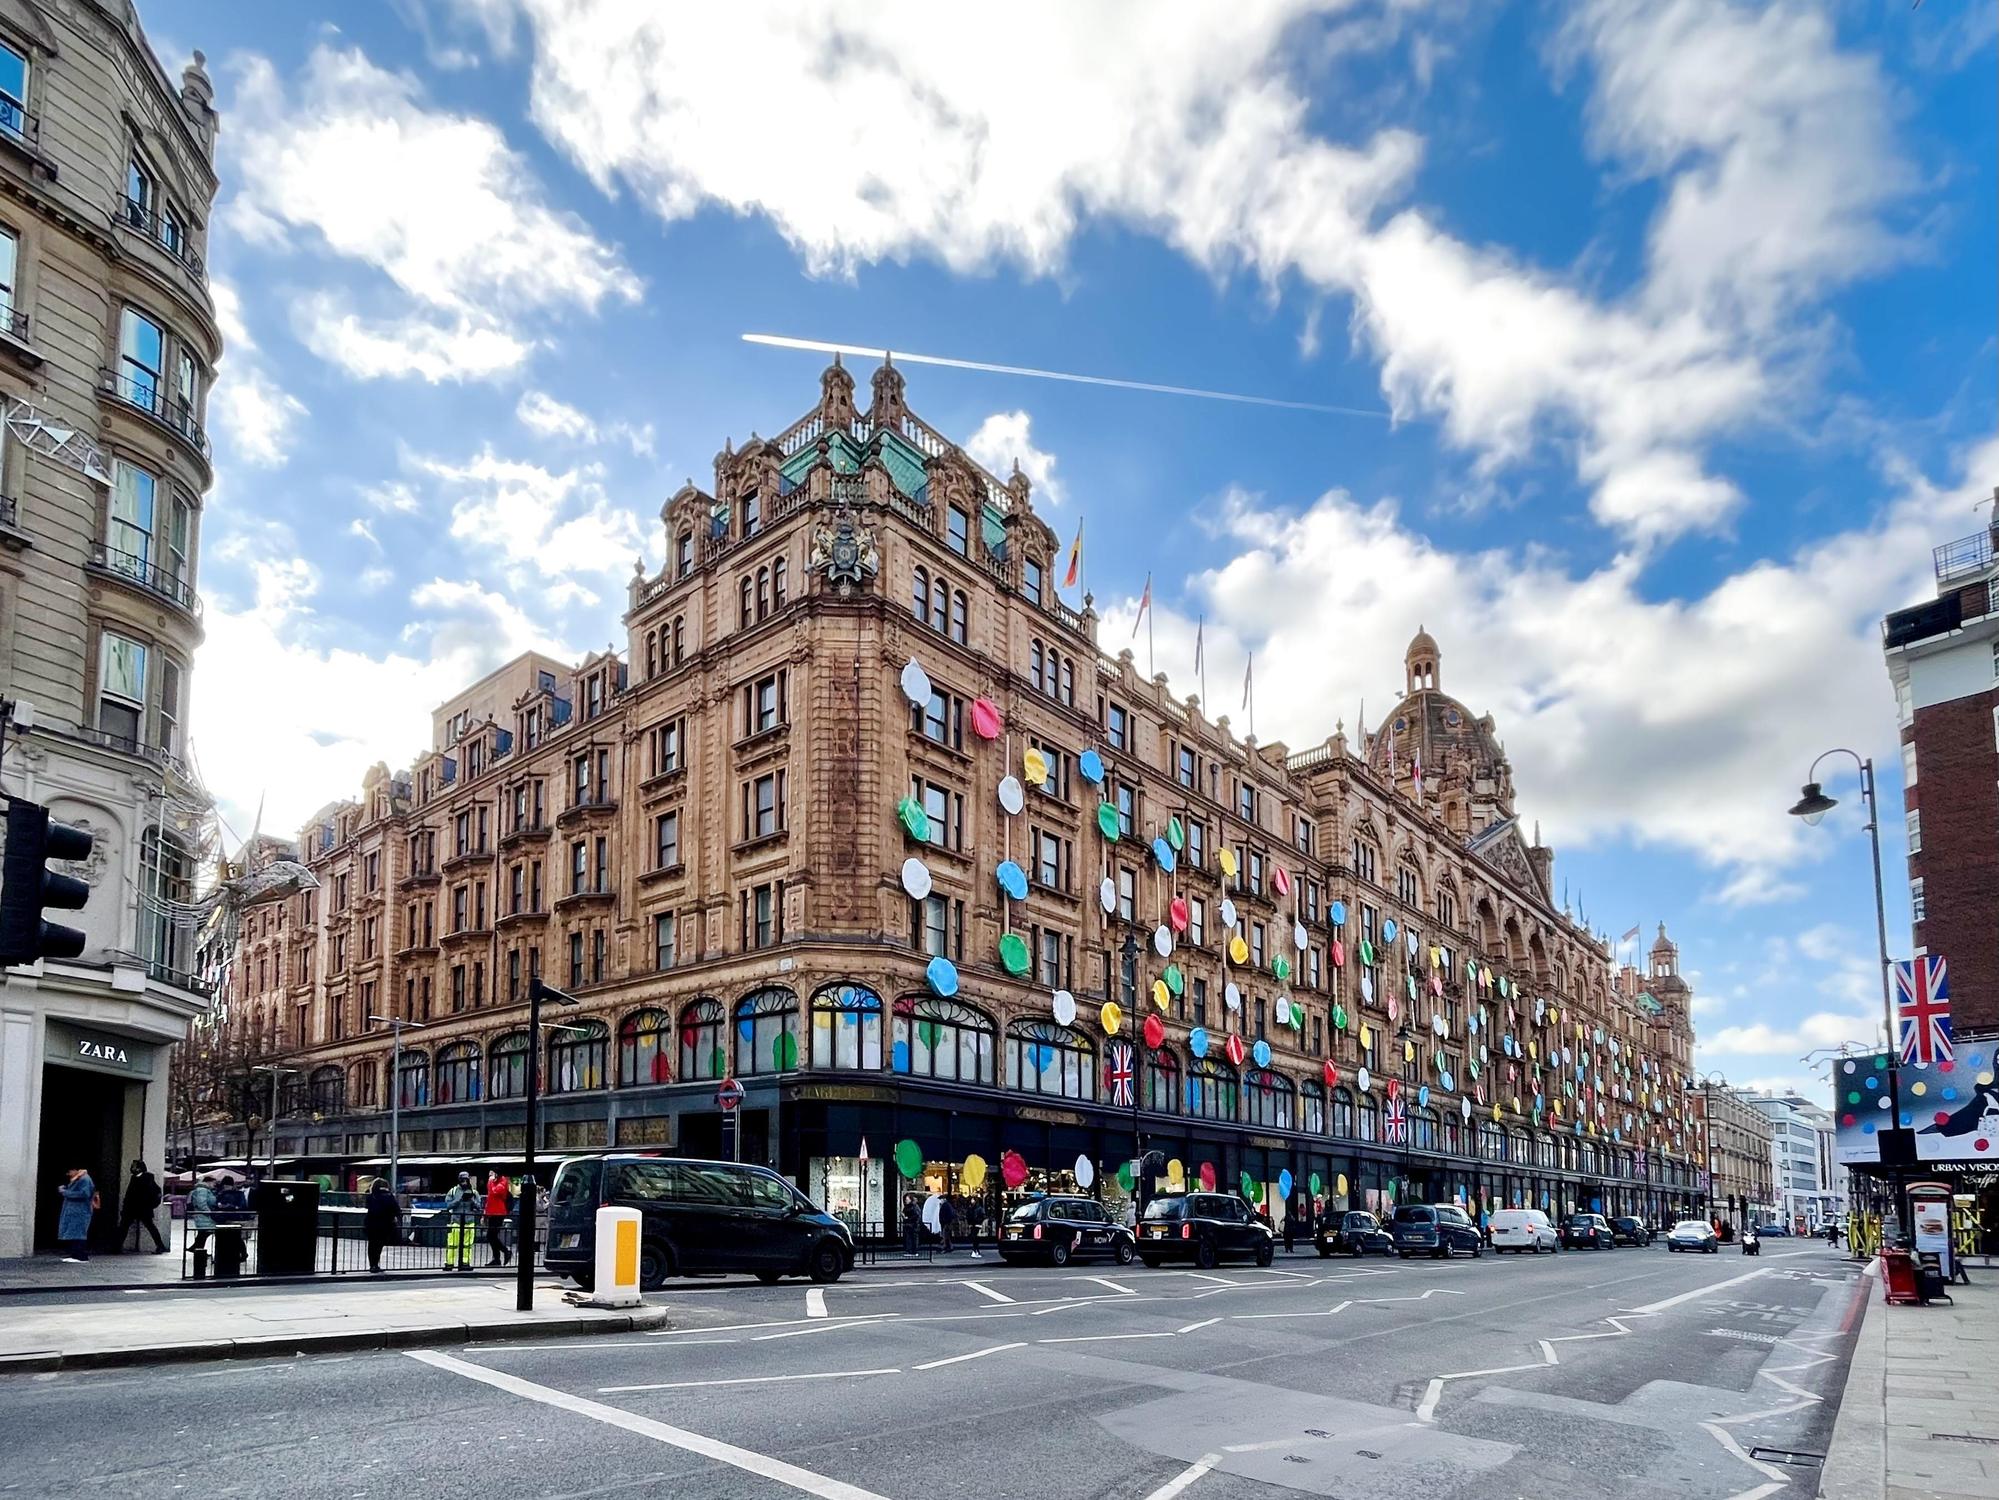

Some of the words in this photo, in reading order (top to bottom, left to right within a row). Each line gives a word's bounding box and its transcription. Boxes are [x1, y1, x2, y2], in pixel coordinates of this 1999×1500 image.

[80, 1041, 128, 1063] ZARA
[1931, 1163, 1967, 1172] URBAN
[1968, 1162, 1999, 1172] VISIO
